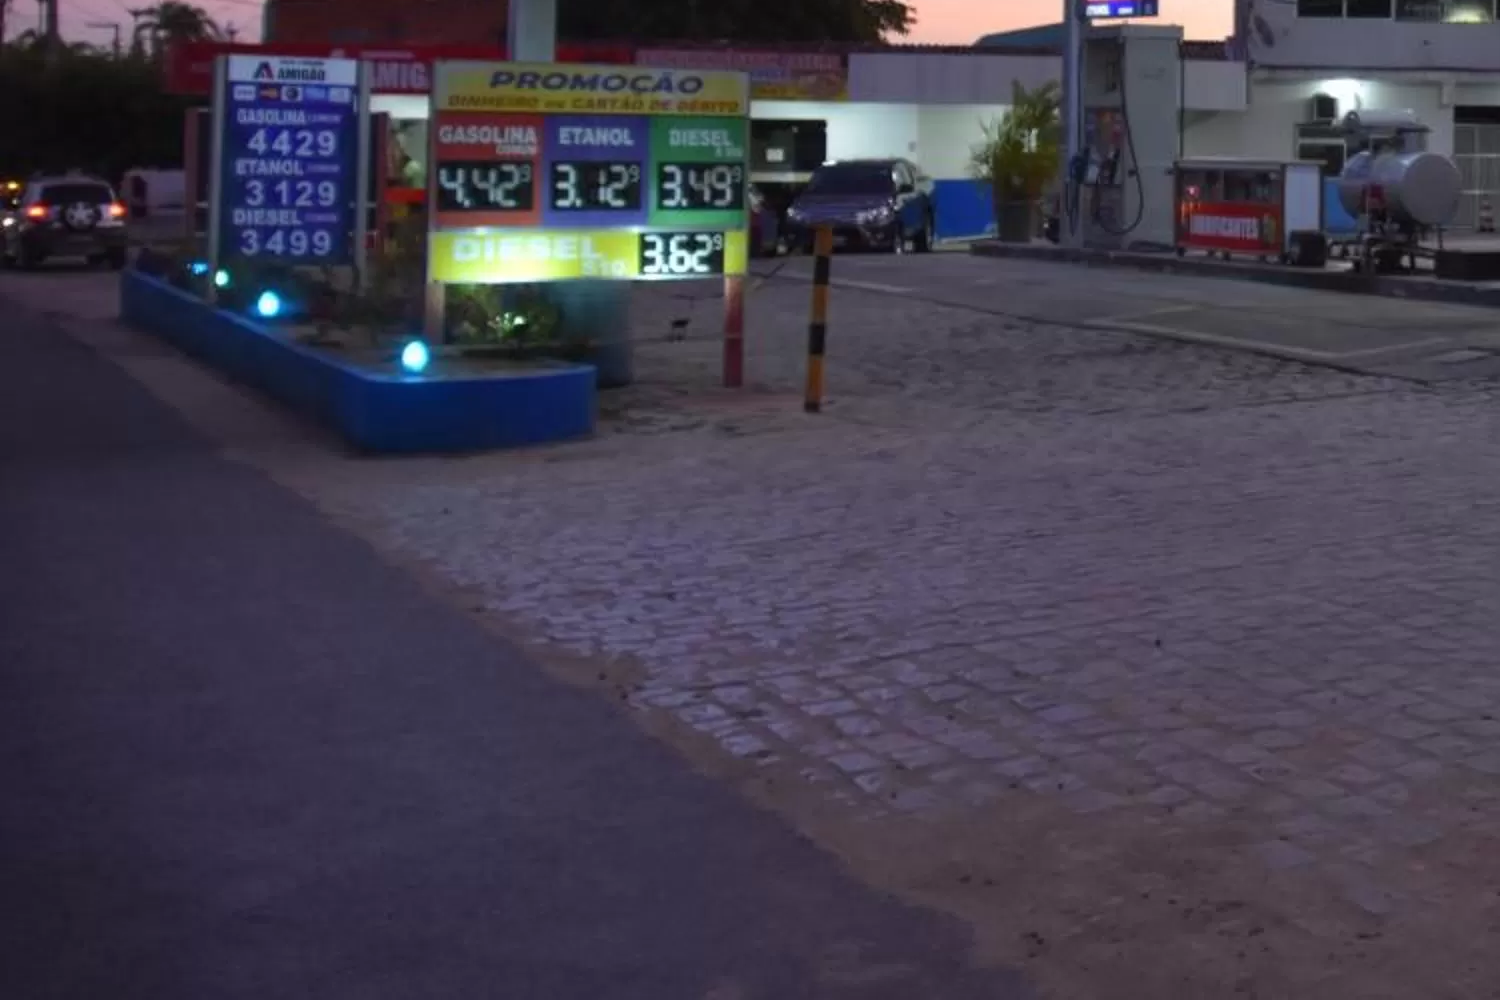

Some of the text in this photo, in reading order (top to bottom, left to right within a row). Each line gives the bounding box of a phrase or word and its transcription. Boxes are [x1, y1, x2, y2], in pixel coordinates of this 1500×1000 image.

[490, 71, 703, 93] PROMOÇÃO
[572, 96, 644, 110] CARTÃO
[238, 109, 305, 124] GASOLINA
[439, 125, 537, 145] GASOLINA
[559, 127, 635, 146] ETANOL
[668, 128, 732, 147] DIESEL
[235, 159, 304, 176] ETANOL
[234, 210, 302, 225] DIESEL
[454, 236, 601, 262] DIESEL
